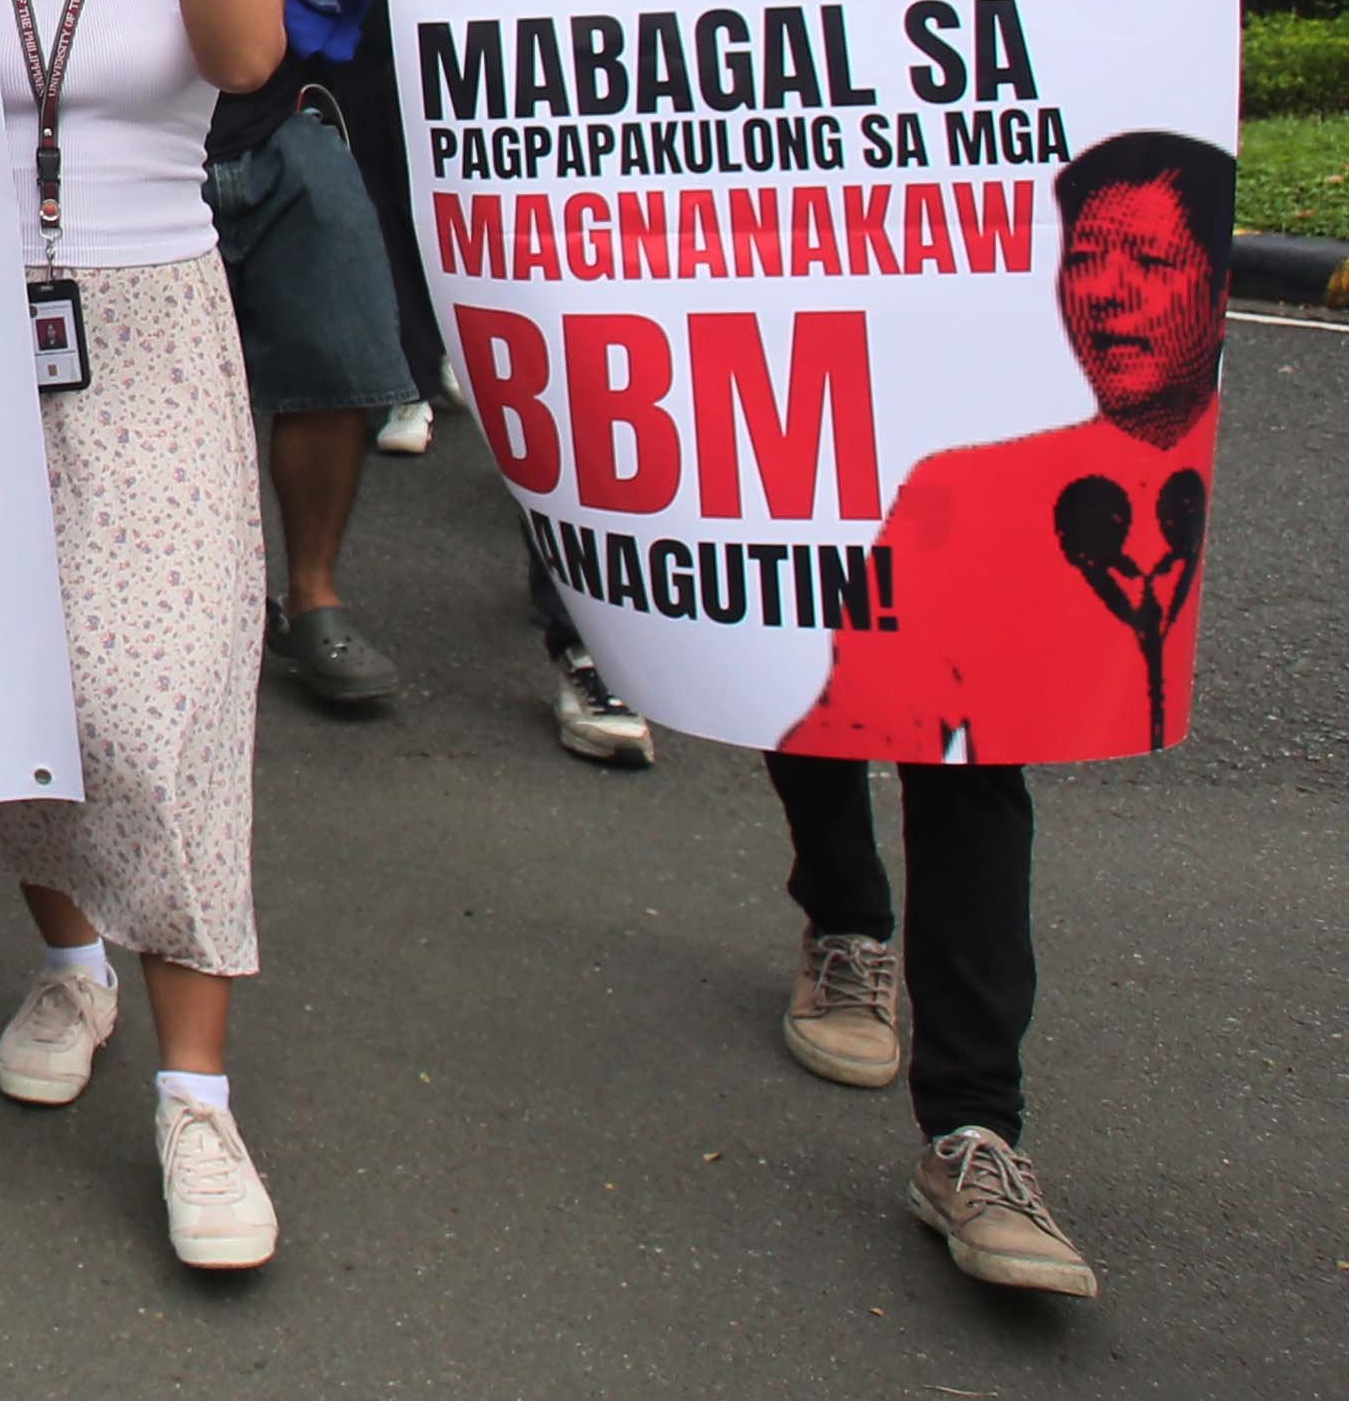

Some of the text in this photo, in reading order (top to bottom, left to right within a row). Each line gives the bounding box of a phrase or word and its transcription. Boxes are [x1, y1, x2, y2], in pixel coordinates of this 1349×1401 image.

[48, 30, 72, 97] UNIVERSITY
[417, 2, 877, 122] MABAGAL
[430, 107, 1071, 181] PAGPAPAKULONG SA MGA
[432, 180, 1037, 283] MAGNANAKAW
[453, 302, 884, 522] BBM
[530, 509, 900, 634] ANAGUTIN!
